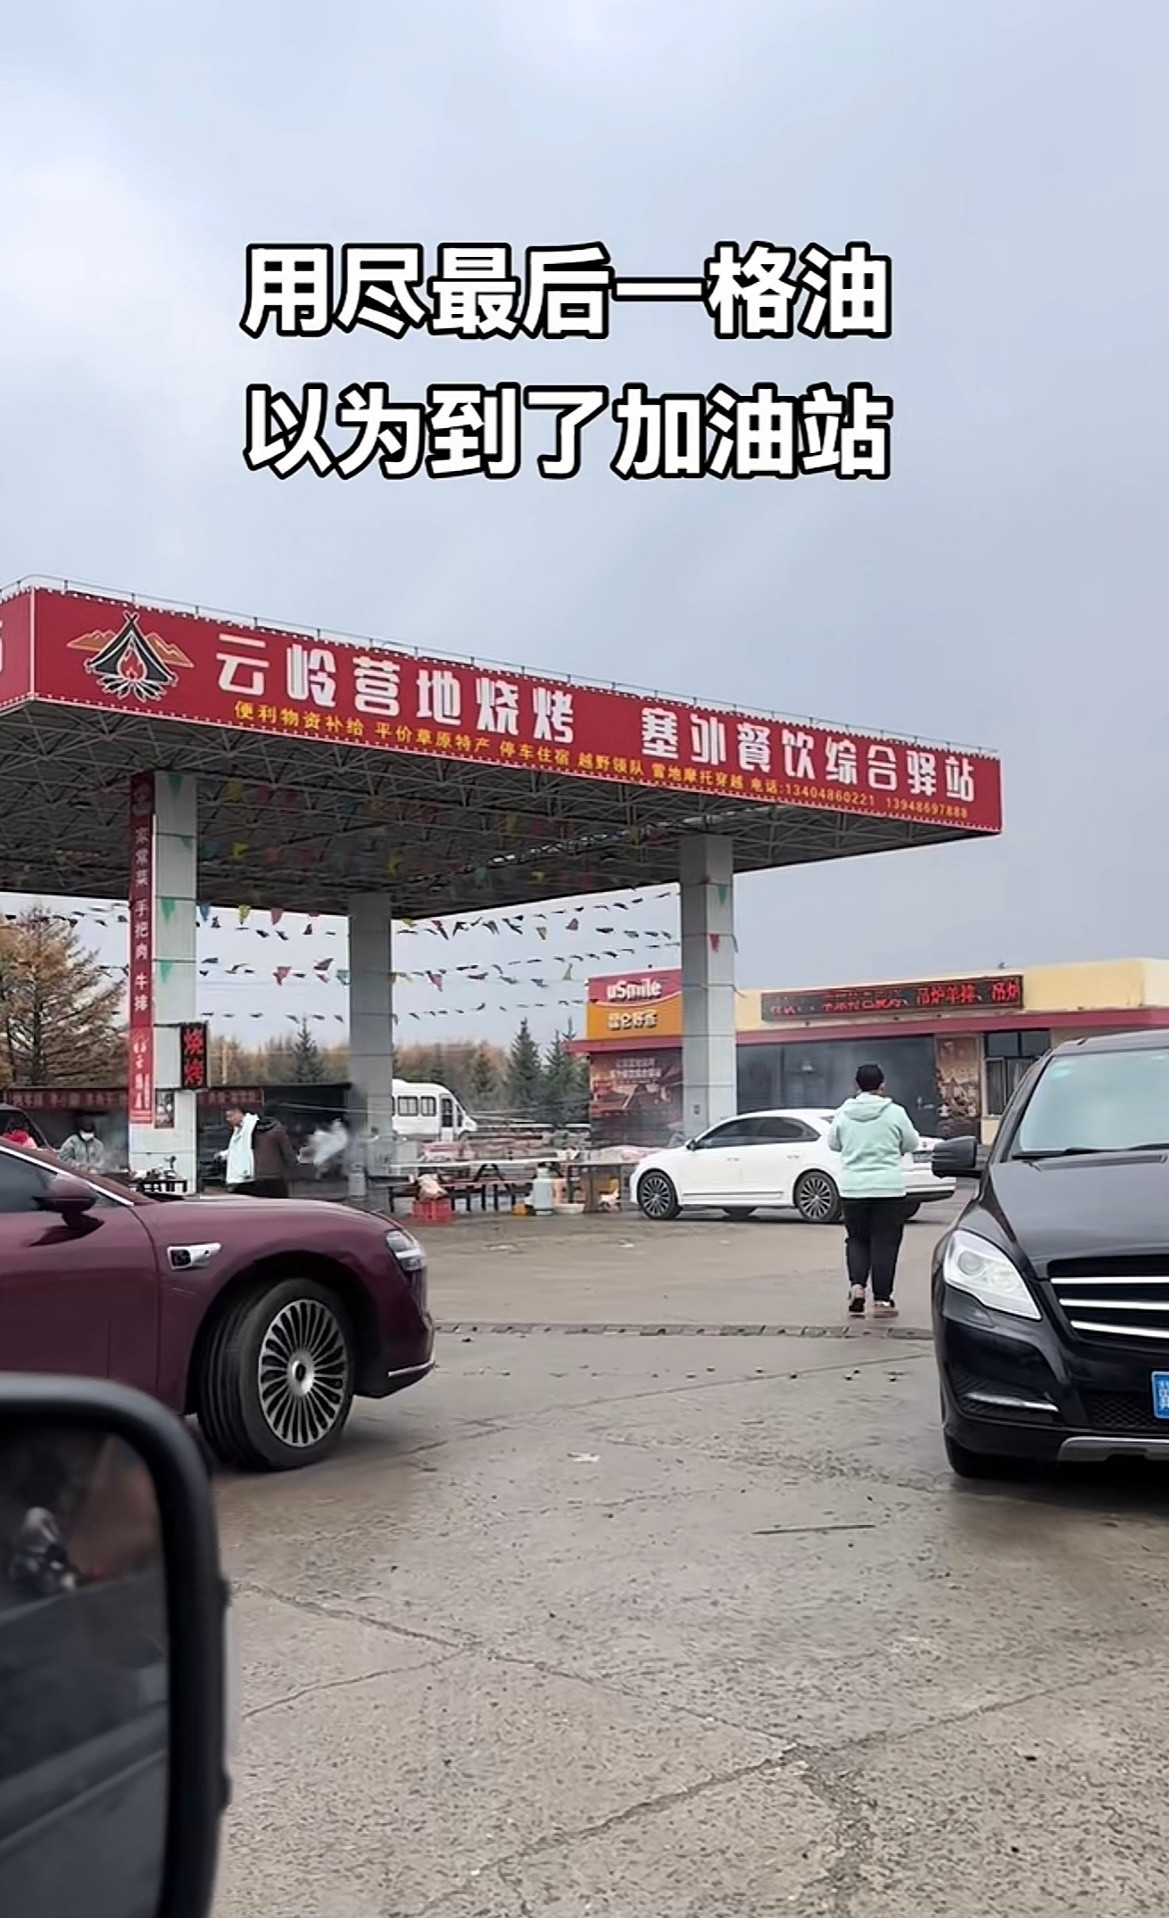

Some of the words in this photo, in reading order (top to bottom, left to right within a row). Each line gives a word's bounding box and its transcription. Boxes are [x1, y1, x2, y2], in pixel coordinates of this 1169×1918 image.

[216, 633, 574, 744] 云岭营地烧烤
[234, 700, 364, 737] 便利物资补给
[375, 722, 490, 753] 平价草原特产
[499, 740, 570, 767] 停车住宿
[578, 752, 645, 776] 越野领队
[651, 763, 744, 790] 雪地摩托穿越
[606, 978, 662, 1000] uSmile
[183, 1026, 205, 1087] 烧烤
